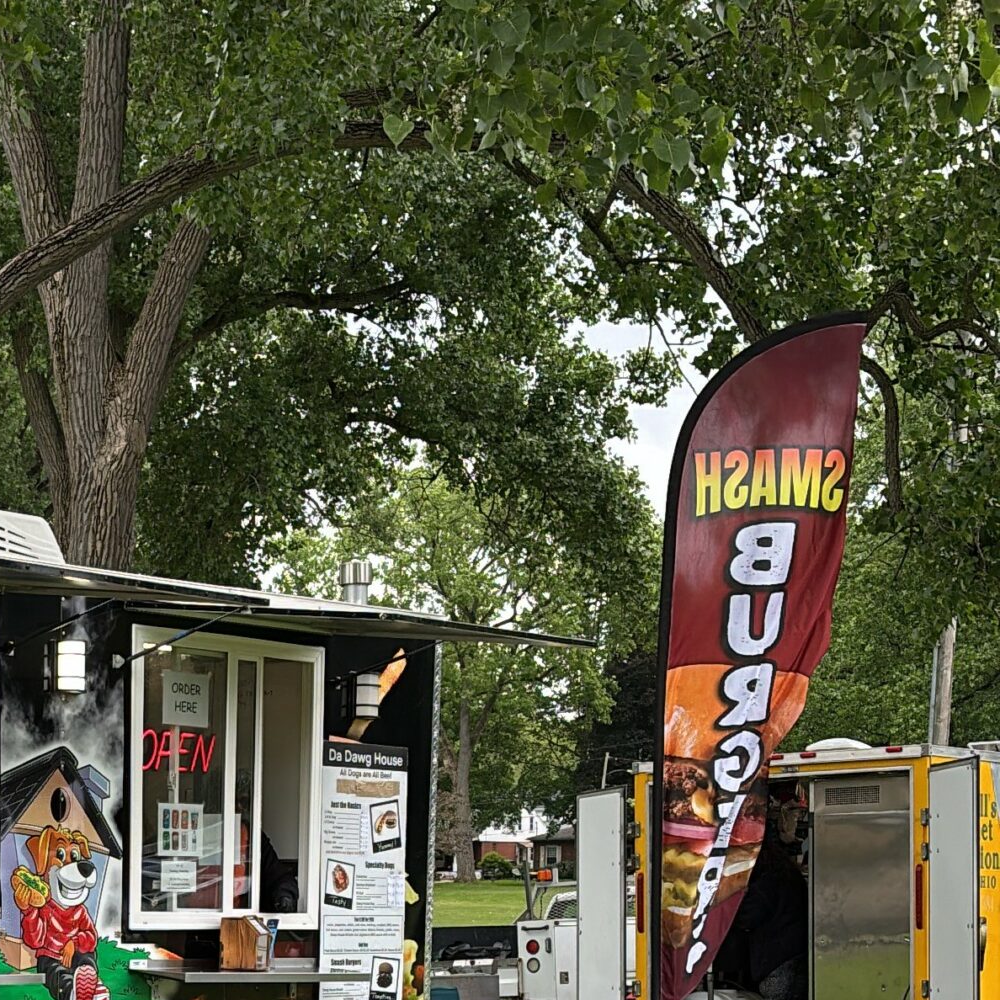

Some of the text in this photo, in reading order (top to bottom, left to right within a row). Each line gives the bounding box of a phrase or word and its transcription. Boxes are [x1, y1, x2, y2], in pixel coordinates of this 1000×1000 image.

[171, 682, 201, 695] ORDER
[174, 701, 198, 713] HERE
[142, 729, 216, 773] OPEN
[329, 748, 403, 767] Da Dawg House
[980, 875, 996, 889] HIO
